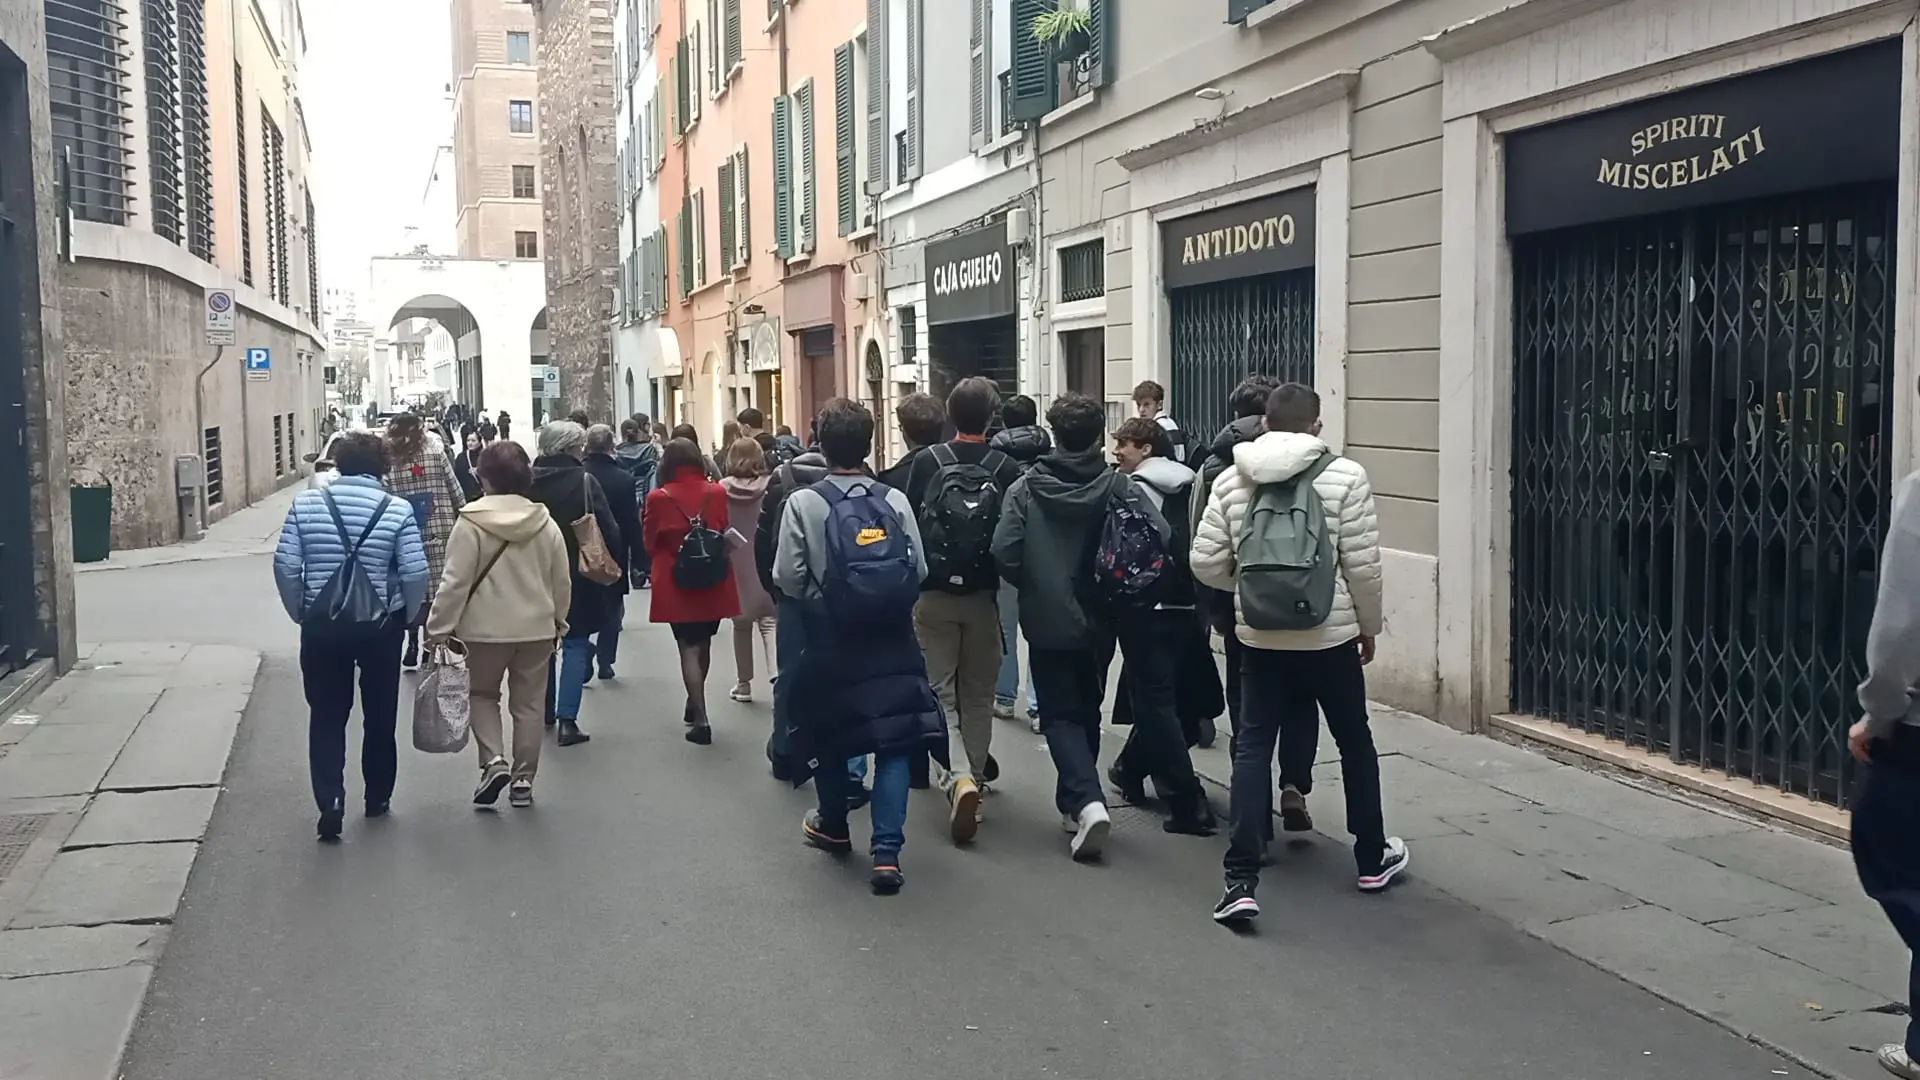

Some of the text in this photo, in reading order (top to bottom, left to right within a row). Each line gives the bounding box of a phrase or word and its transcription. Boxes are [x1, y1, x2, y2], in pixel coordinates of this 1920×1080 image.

[1631, 114, 1726, 156] SPIRITI
[1597, 126, 1766, 190] MISCELATI
[1182, 214, 1295, 265] ANTIDOTO
[960, 251, 1001, 290] GUELFO
[251, 349, 267, 368] P
